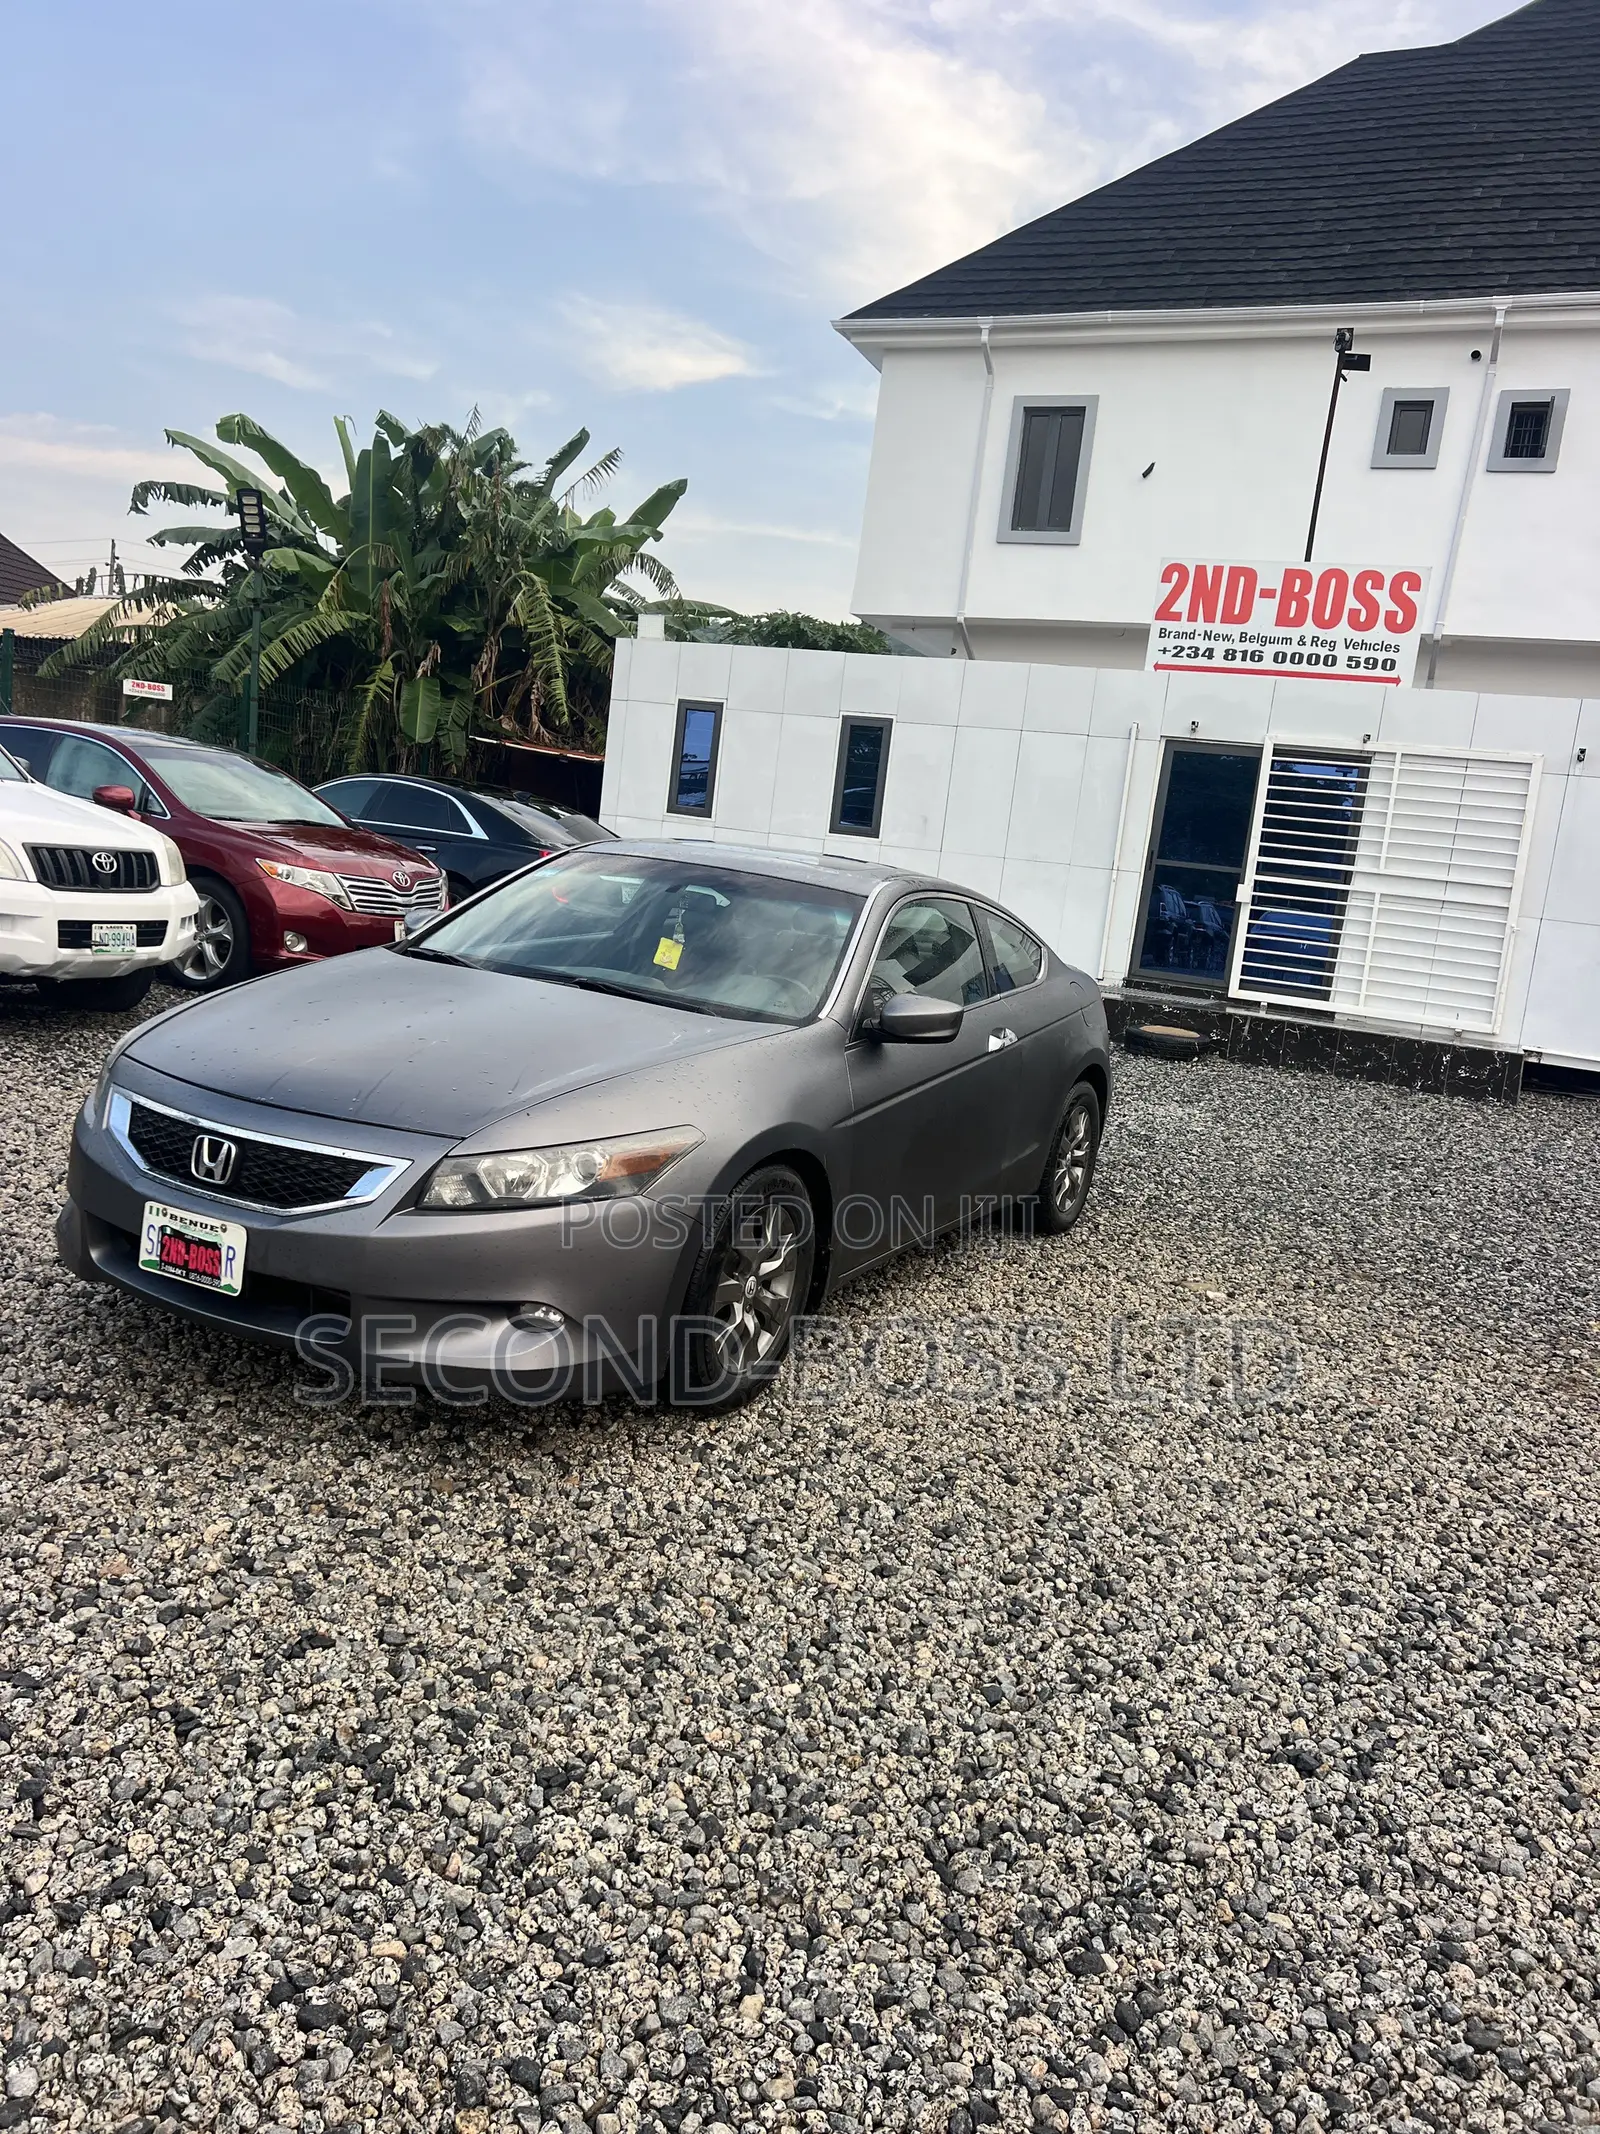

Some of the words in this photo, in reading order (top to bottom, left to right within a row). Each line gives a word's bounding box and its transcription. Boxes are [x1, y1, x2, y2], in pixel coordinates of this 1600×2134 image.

[1154, 562, 1422, 634] 2ND-BOSS
[1158, 627, 1235, 644] Brand-New,
[1297, 634, 1307, 647] &
[1310, 635, 1337, 652] Reg
[1344, 638, 1401, 653] Vehicles
[1158, 645, 1215, 660] +234
[1223, 648, 1264, 663] 816
[1272, 651, 1338, 667] 0000
[1346, 655, 1397, 672] 590
[131, 681, 166, 692] 2ND-BOSS
[169, 1213, 220, 1233] BENUE
[161, 1235, 220, 1278] 2ND-BOSS
